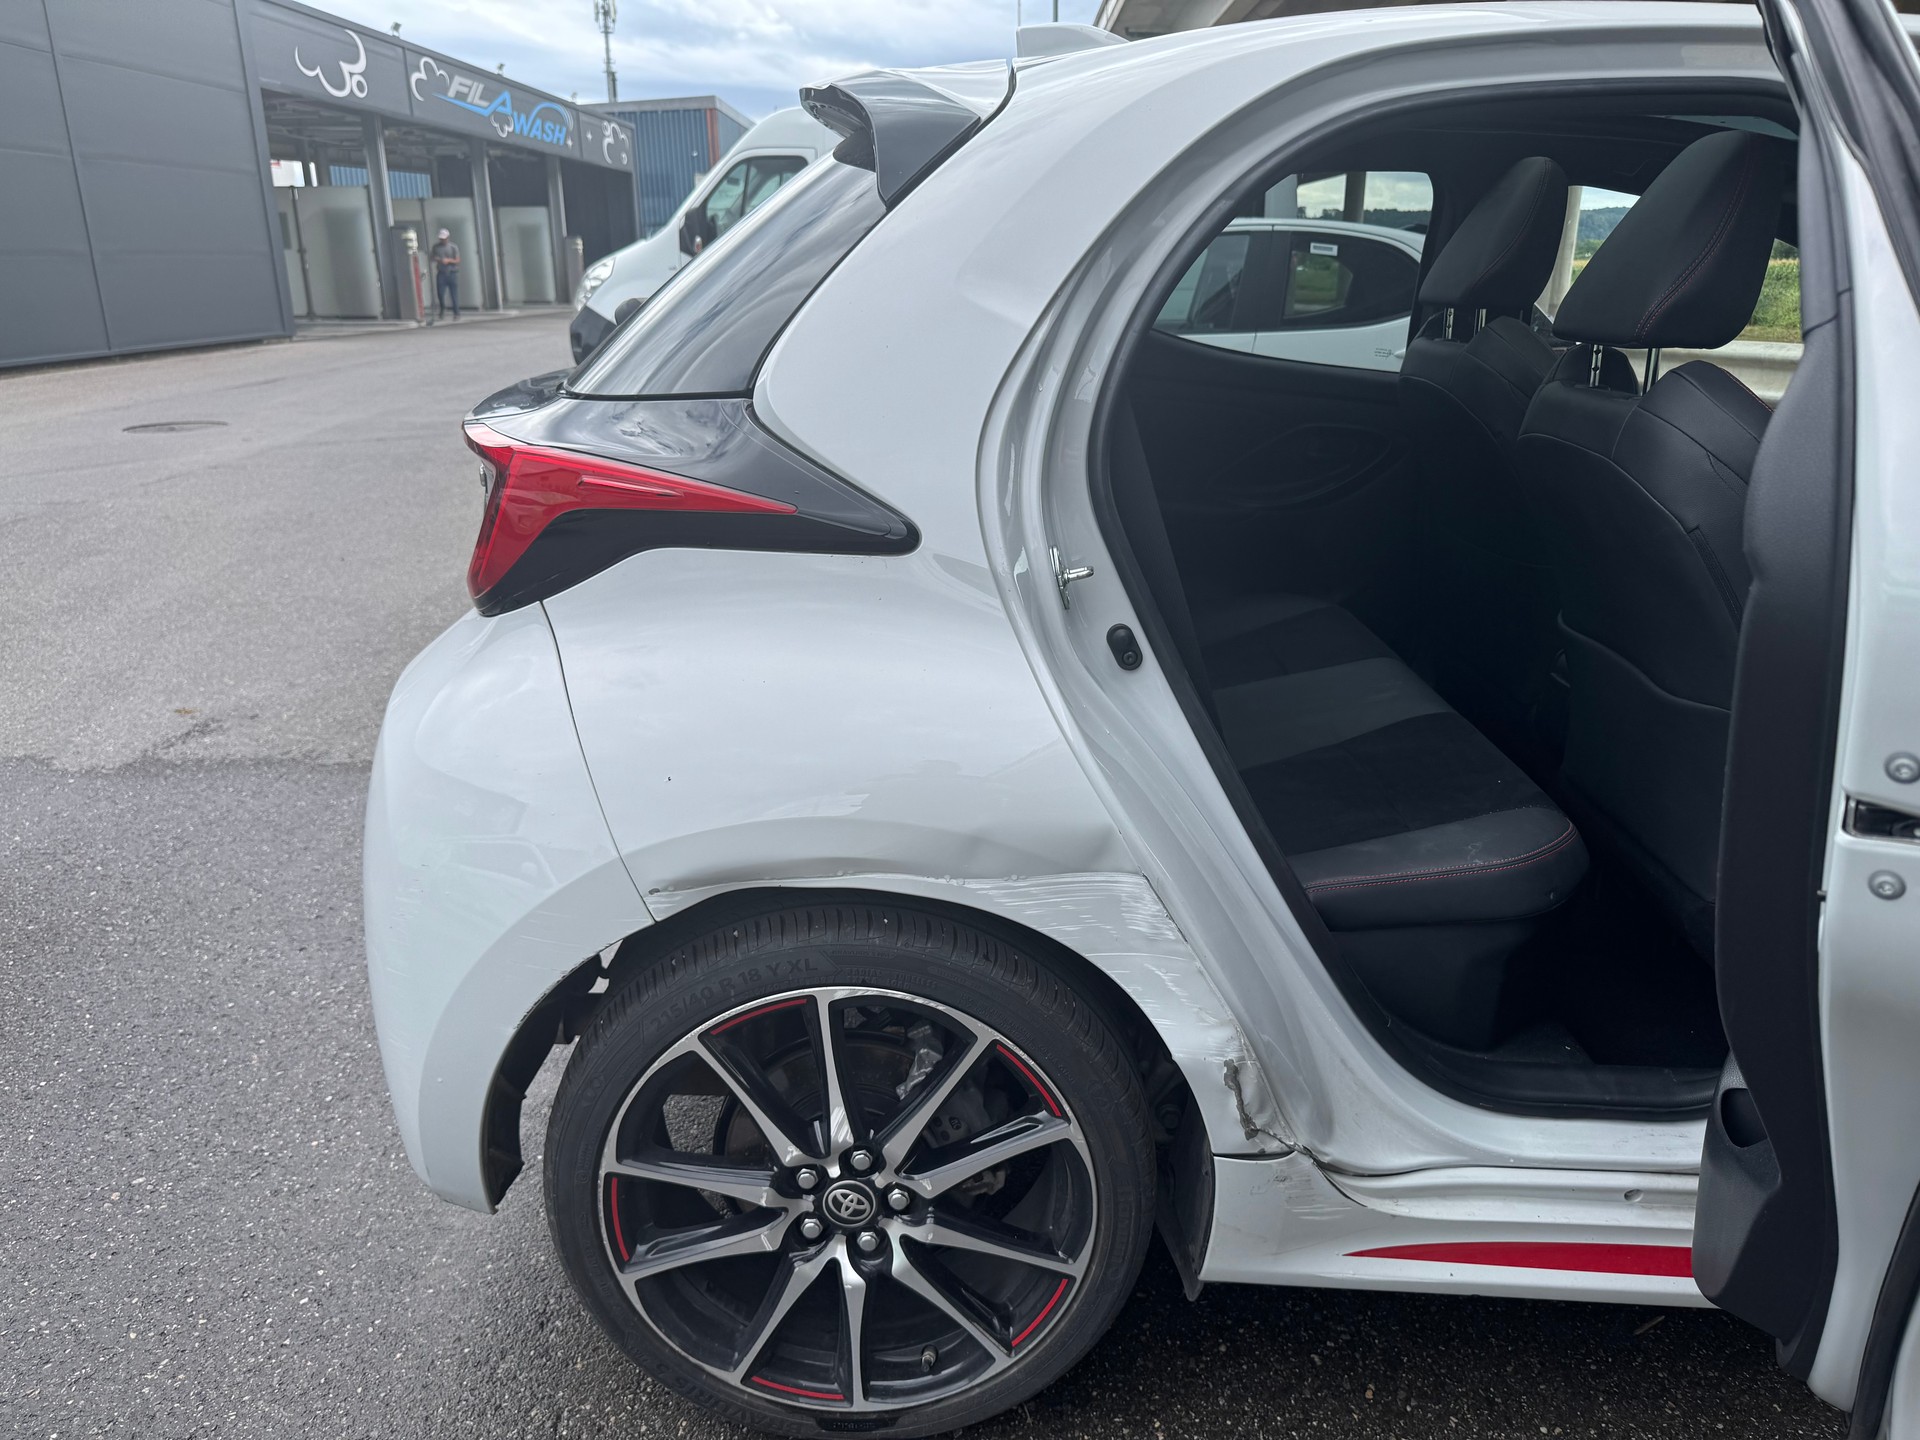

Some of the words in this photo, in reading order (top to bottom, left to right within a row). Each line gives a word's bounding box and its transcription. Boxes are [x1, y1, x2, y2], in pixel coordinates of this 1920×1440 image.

[446, 74, 513, 117] FILA
[512, 109, 568, 146] WASH
[650, 986, 714, 1033] 215/40
[717, 977, 736, 992] R
[738, 968, 762, 985] 18
[765, 961, 781, 977] Y
[786, 958, 818, 974] XL
